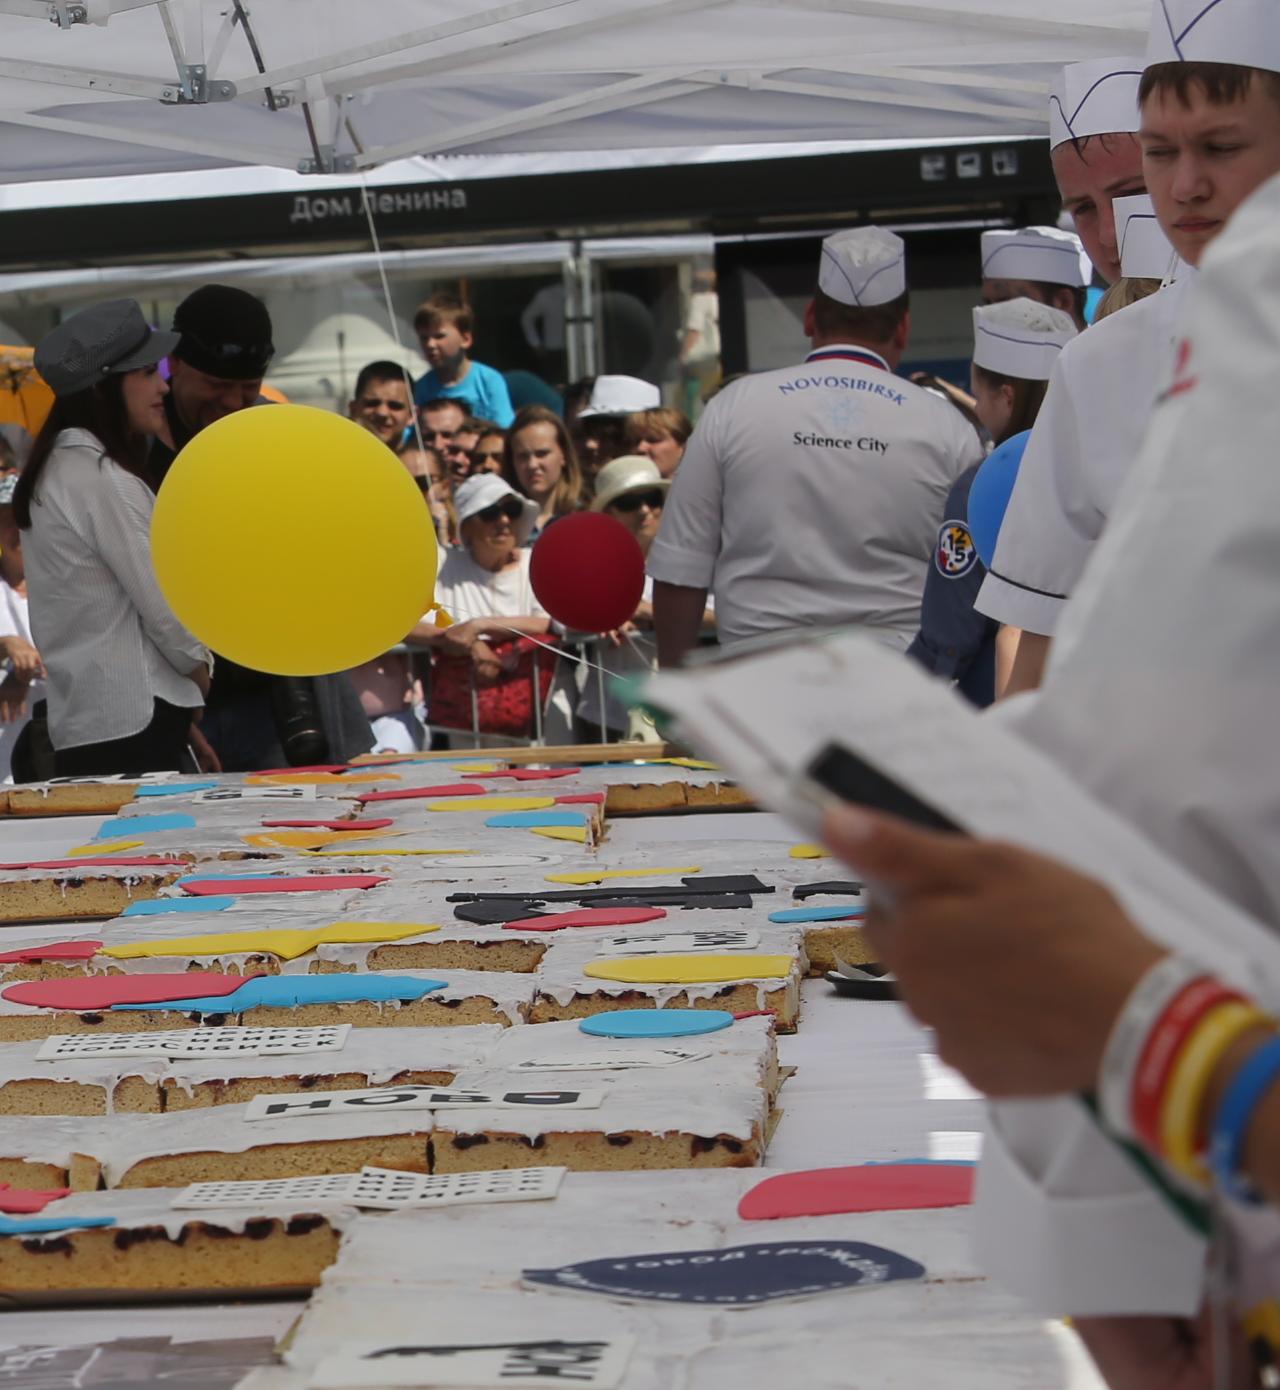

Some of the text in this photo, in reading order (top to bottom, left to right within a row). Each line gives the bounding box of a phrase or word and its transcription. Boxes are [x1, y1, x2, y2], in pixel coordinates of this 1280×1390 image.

[290, 189, 467, 222] Дом Ленина
[779, 376, 907, 406] NOVOSIBIRSK
[793, 432, 889, 456] Science City
